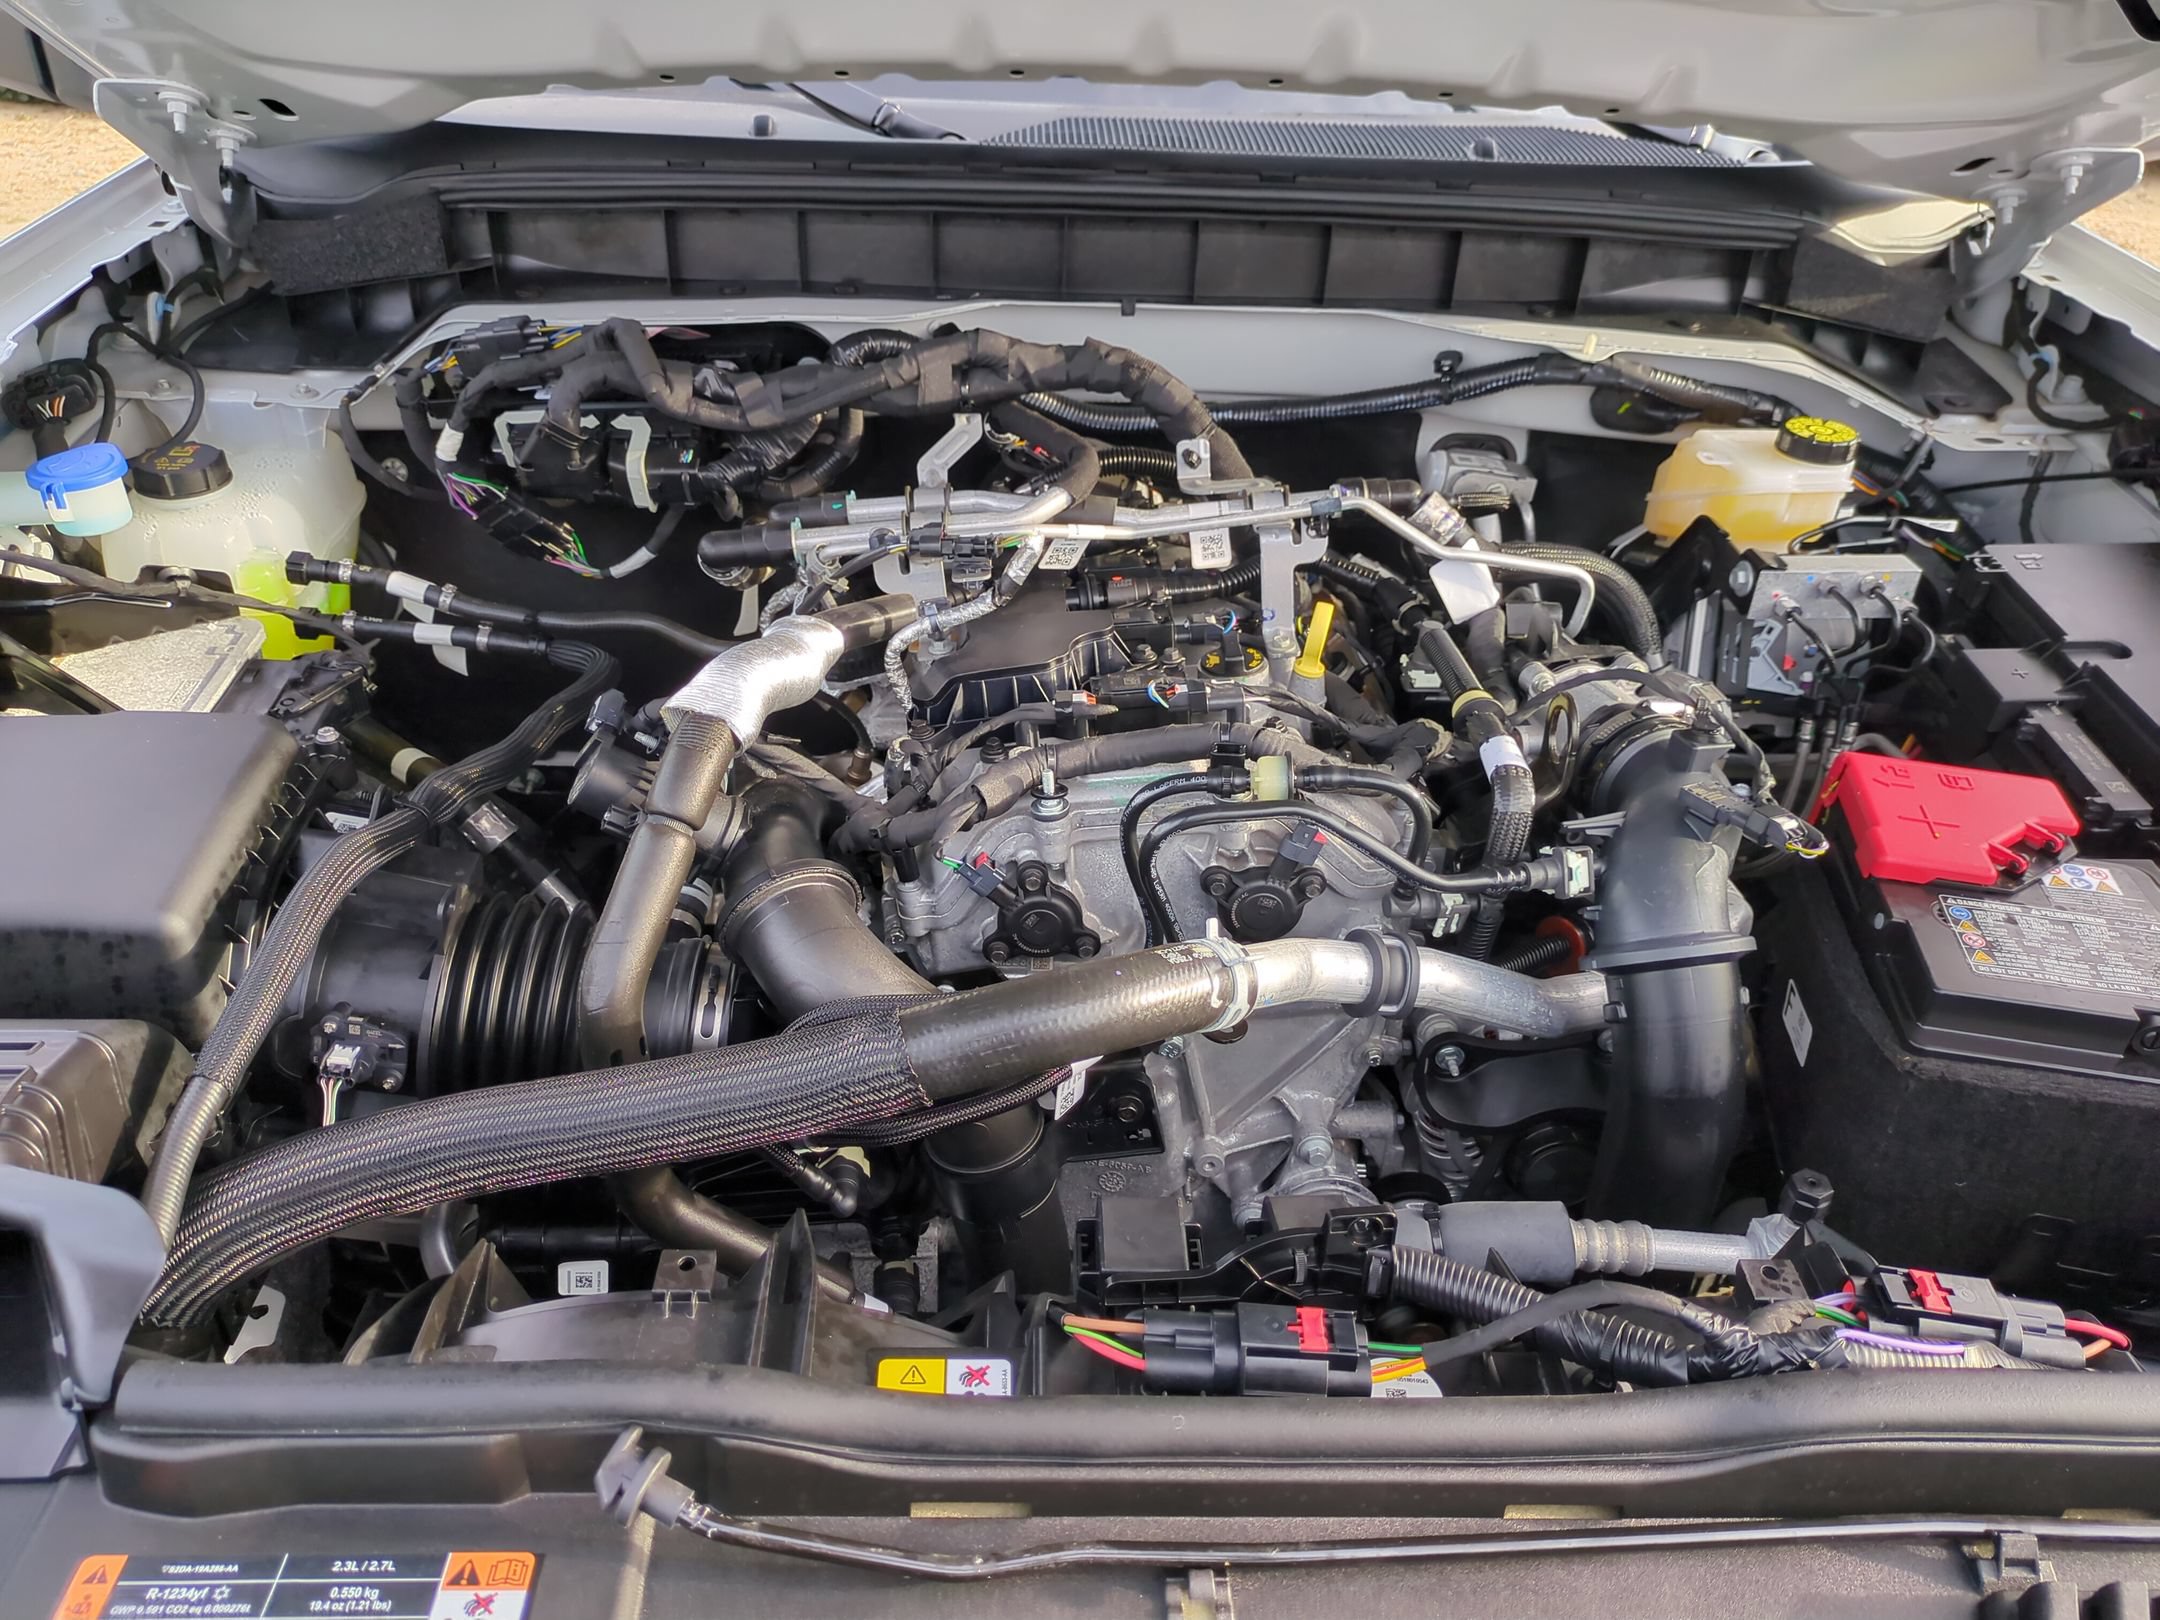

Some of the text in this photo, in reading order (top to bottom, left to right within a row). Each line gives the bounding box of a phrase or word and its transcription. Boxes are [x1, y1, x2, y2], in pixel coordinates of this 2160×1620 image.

[331, 1561, 359, 1573] 2.3L
[368, 1560, 396, 1572] 2.7L
[145, 1586, 211, 1602] R-1234yf
[329, 1586, 379, 1600] 0.550 kg
[309, 1599, 393, 1613] 19.4 oz (1.21 lbs)
